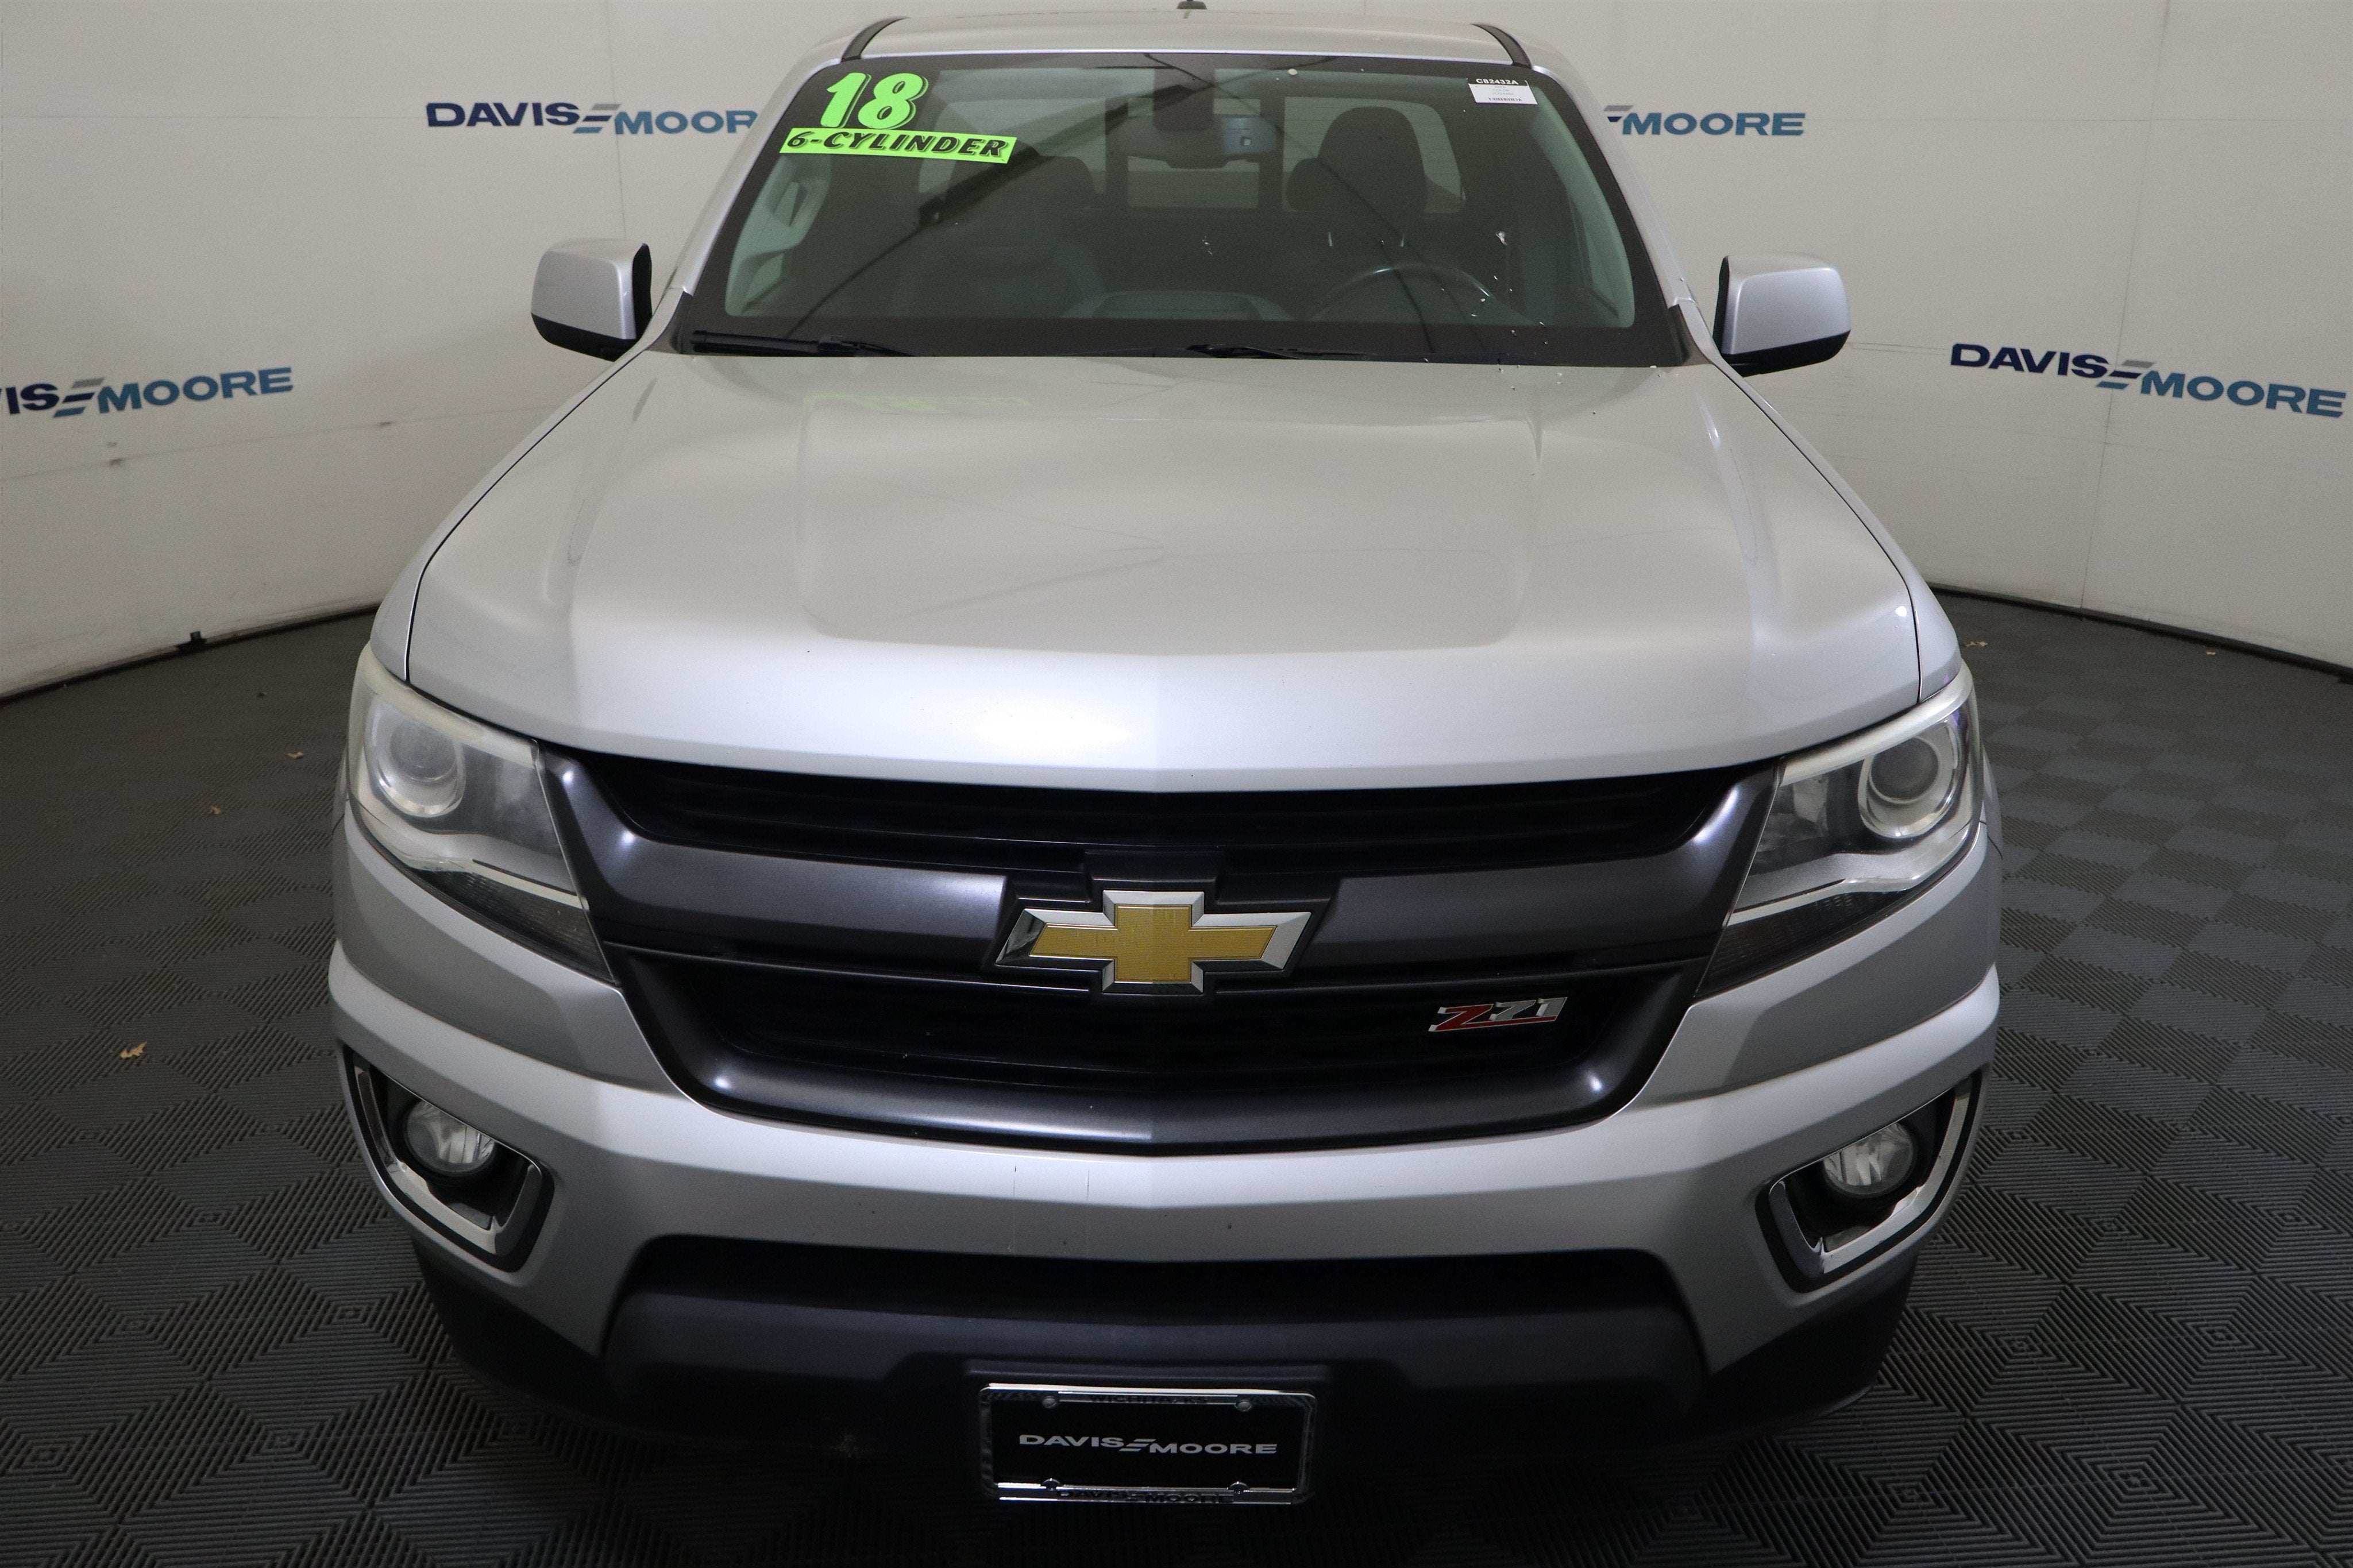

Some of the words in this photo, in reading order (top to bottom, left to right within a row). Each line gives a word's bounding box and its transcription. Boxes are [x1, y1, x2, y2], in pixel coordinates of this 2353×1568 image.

[820, 72, 929, 130] 18
[426, 102, 580, 126] DAVIS
[614, 110, 758, 134] MOOR
[1622, 112, 1806, 136] MOORE
[786, 130, 1008, 159] 6-CYLINDER
[0, 383, 60, 415] IS
[97, 366, 294, 414] MOORE
[1950, 342, 2109, 379] DAVIS
[2140, 370, 2347, 418] MOORE
[1428, 997, 1568, 1032] Z71
[1019, 1434, 1125, 1448] DAVIS
[1149, 1442, 1278, 1454] MOORE
